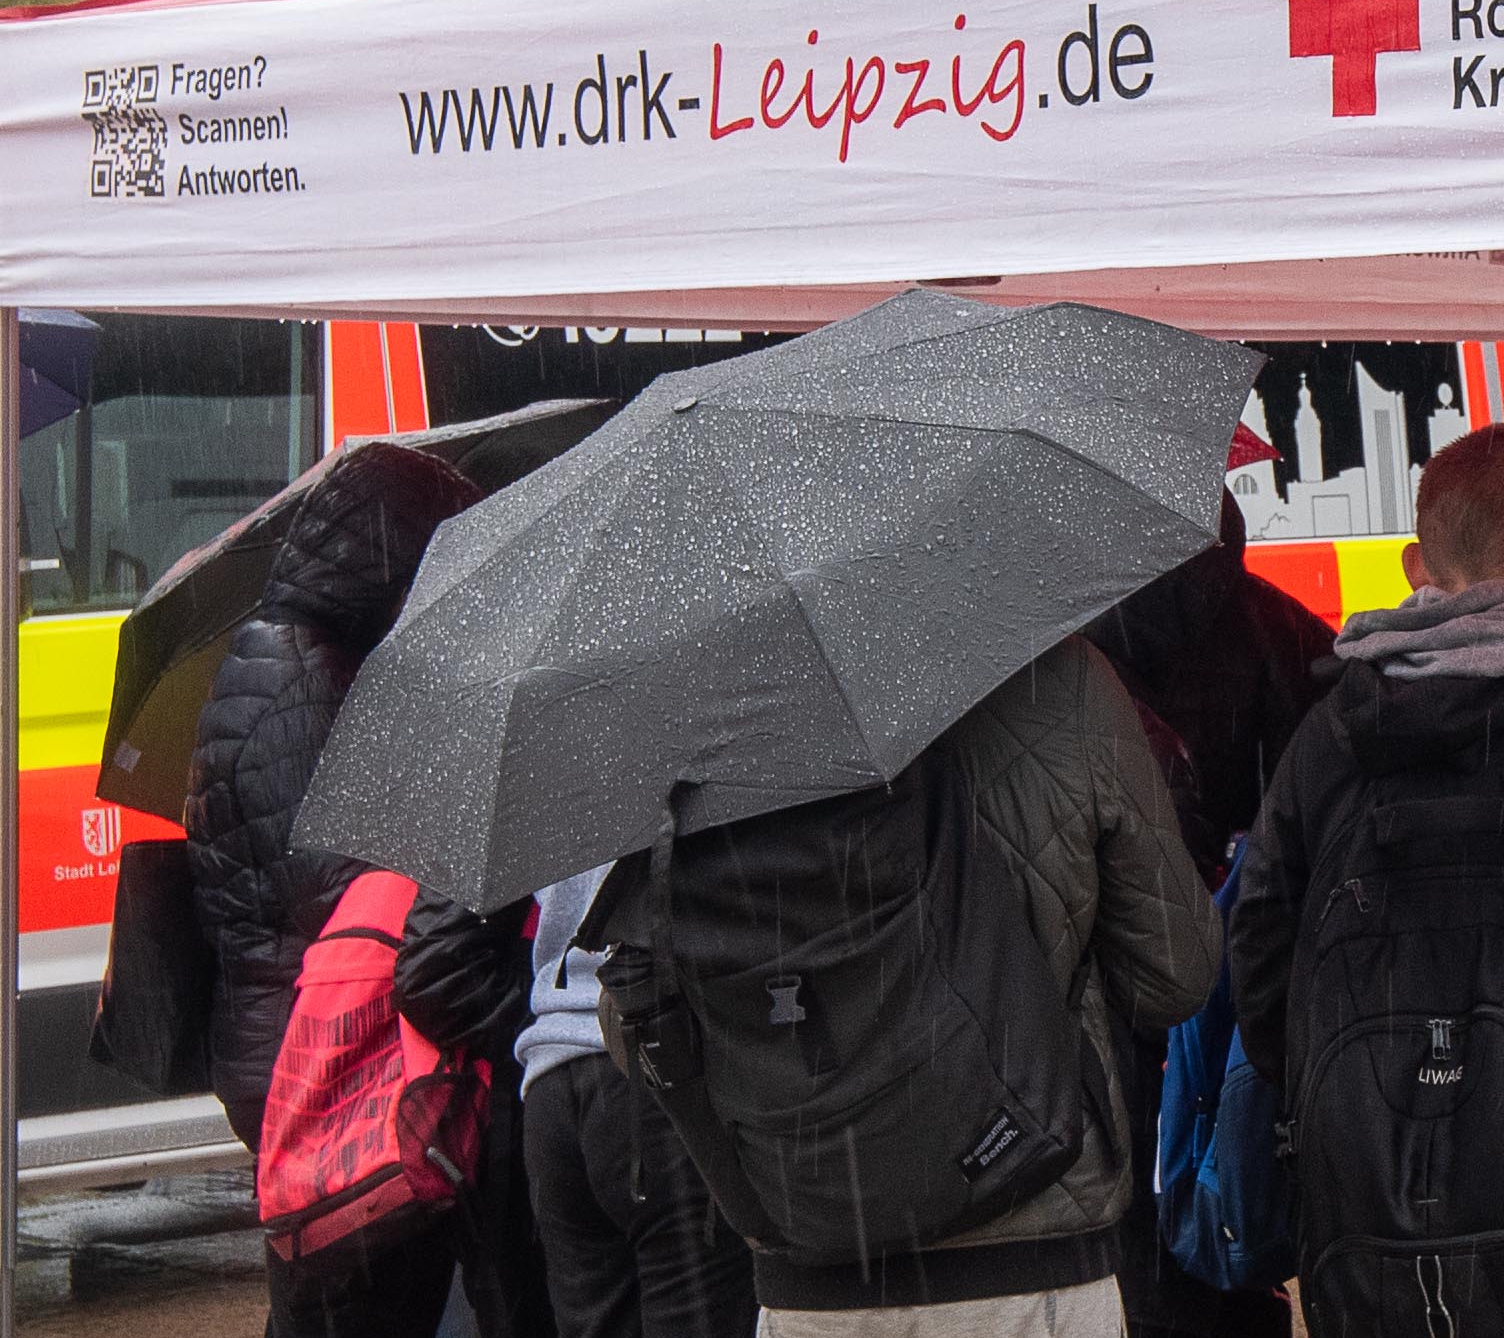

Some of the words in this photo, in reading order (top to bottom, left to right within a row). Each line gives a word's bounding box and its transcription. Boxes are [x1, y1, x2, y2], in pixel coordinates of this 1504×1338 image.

[169, 53, 268, 101] Fragen?
[397, 2, 1156, 165] www.drk-Leipzig.de
[177, 105, 290, 146] Scannen!
[176, 161, 308, 199] Antworten.
[53, 863, 95, 882] Stadt
